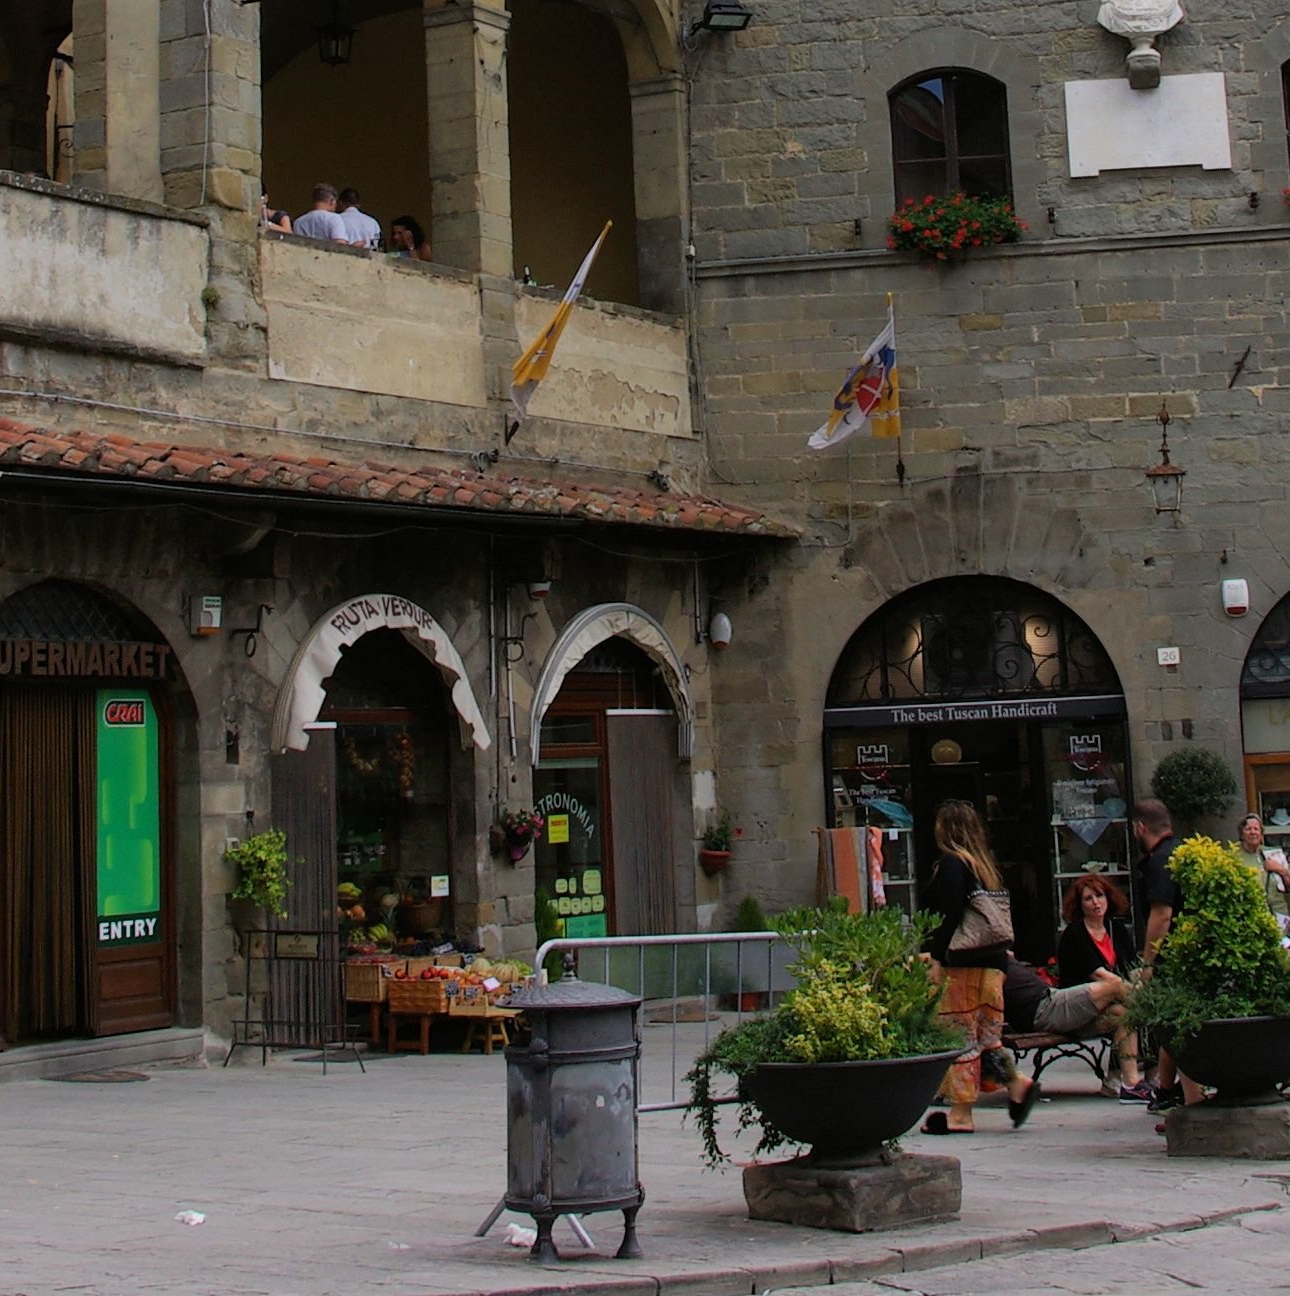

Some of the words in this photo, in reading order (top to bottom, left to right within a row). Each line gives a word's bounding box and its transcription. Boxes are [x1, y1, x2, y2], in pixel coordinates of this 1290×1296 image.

[1162, 651, 1176, 661] 26
[106, 703, 143, 725] CRAI
[891, 709, 915, 723] The
[918, 708, 943, 722] best
[945, 706, 989, 721] Tuscan
[990, 702, 1058, 719] Handicraft
[99, 918, 157, 942] ENTRY
